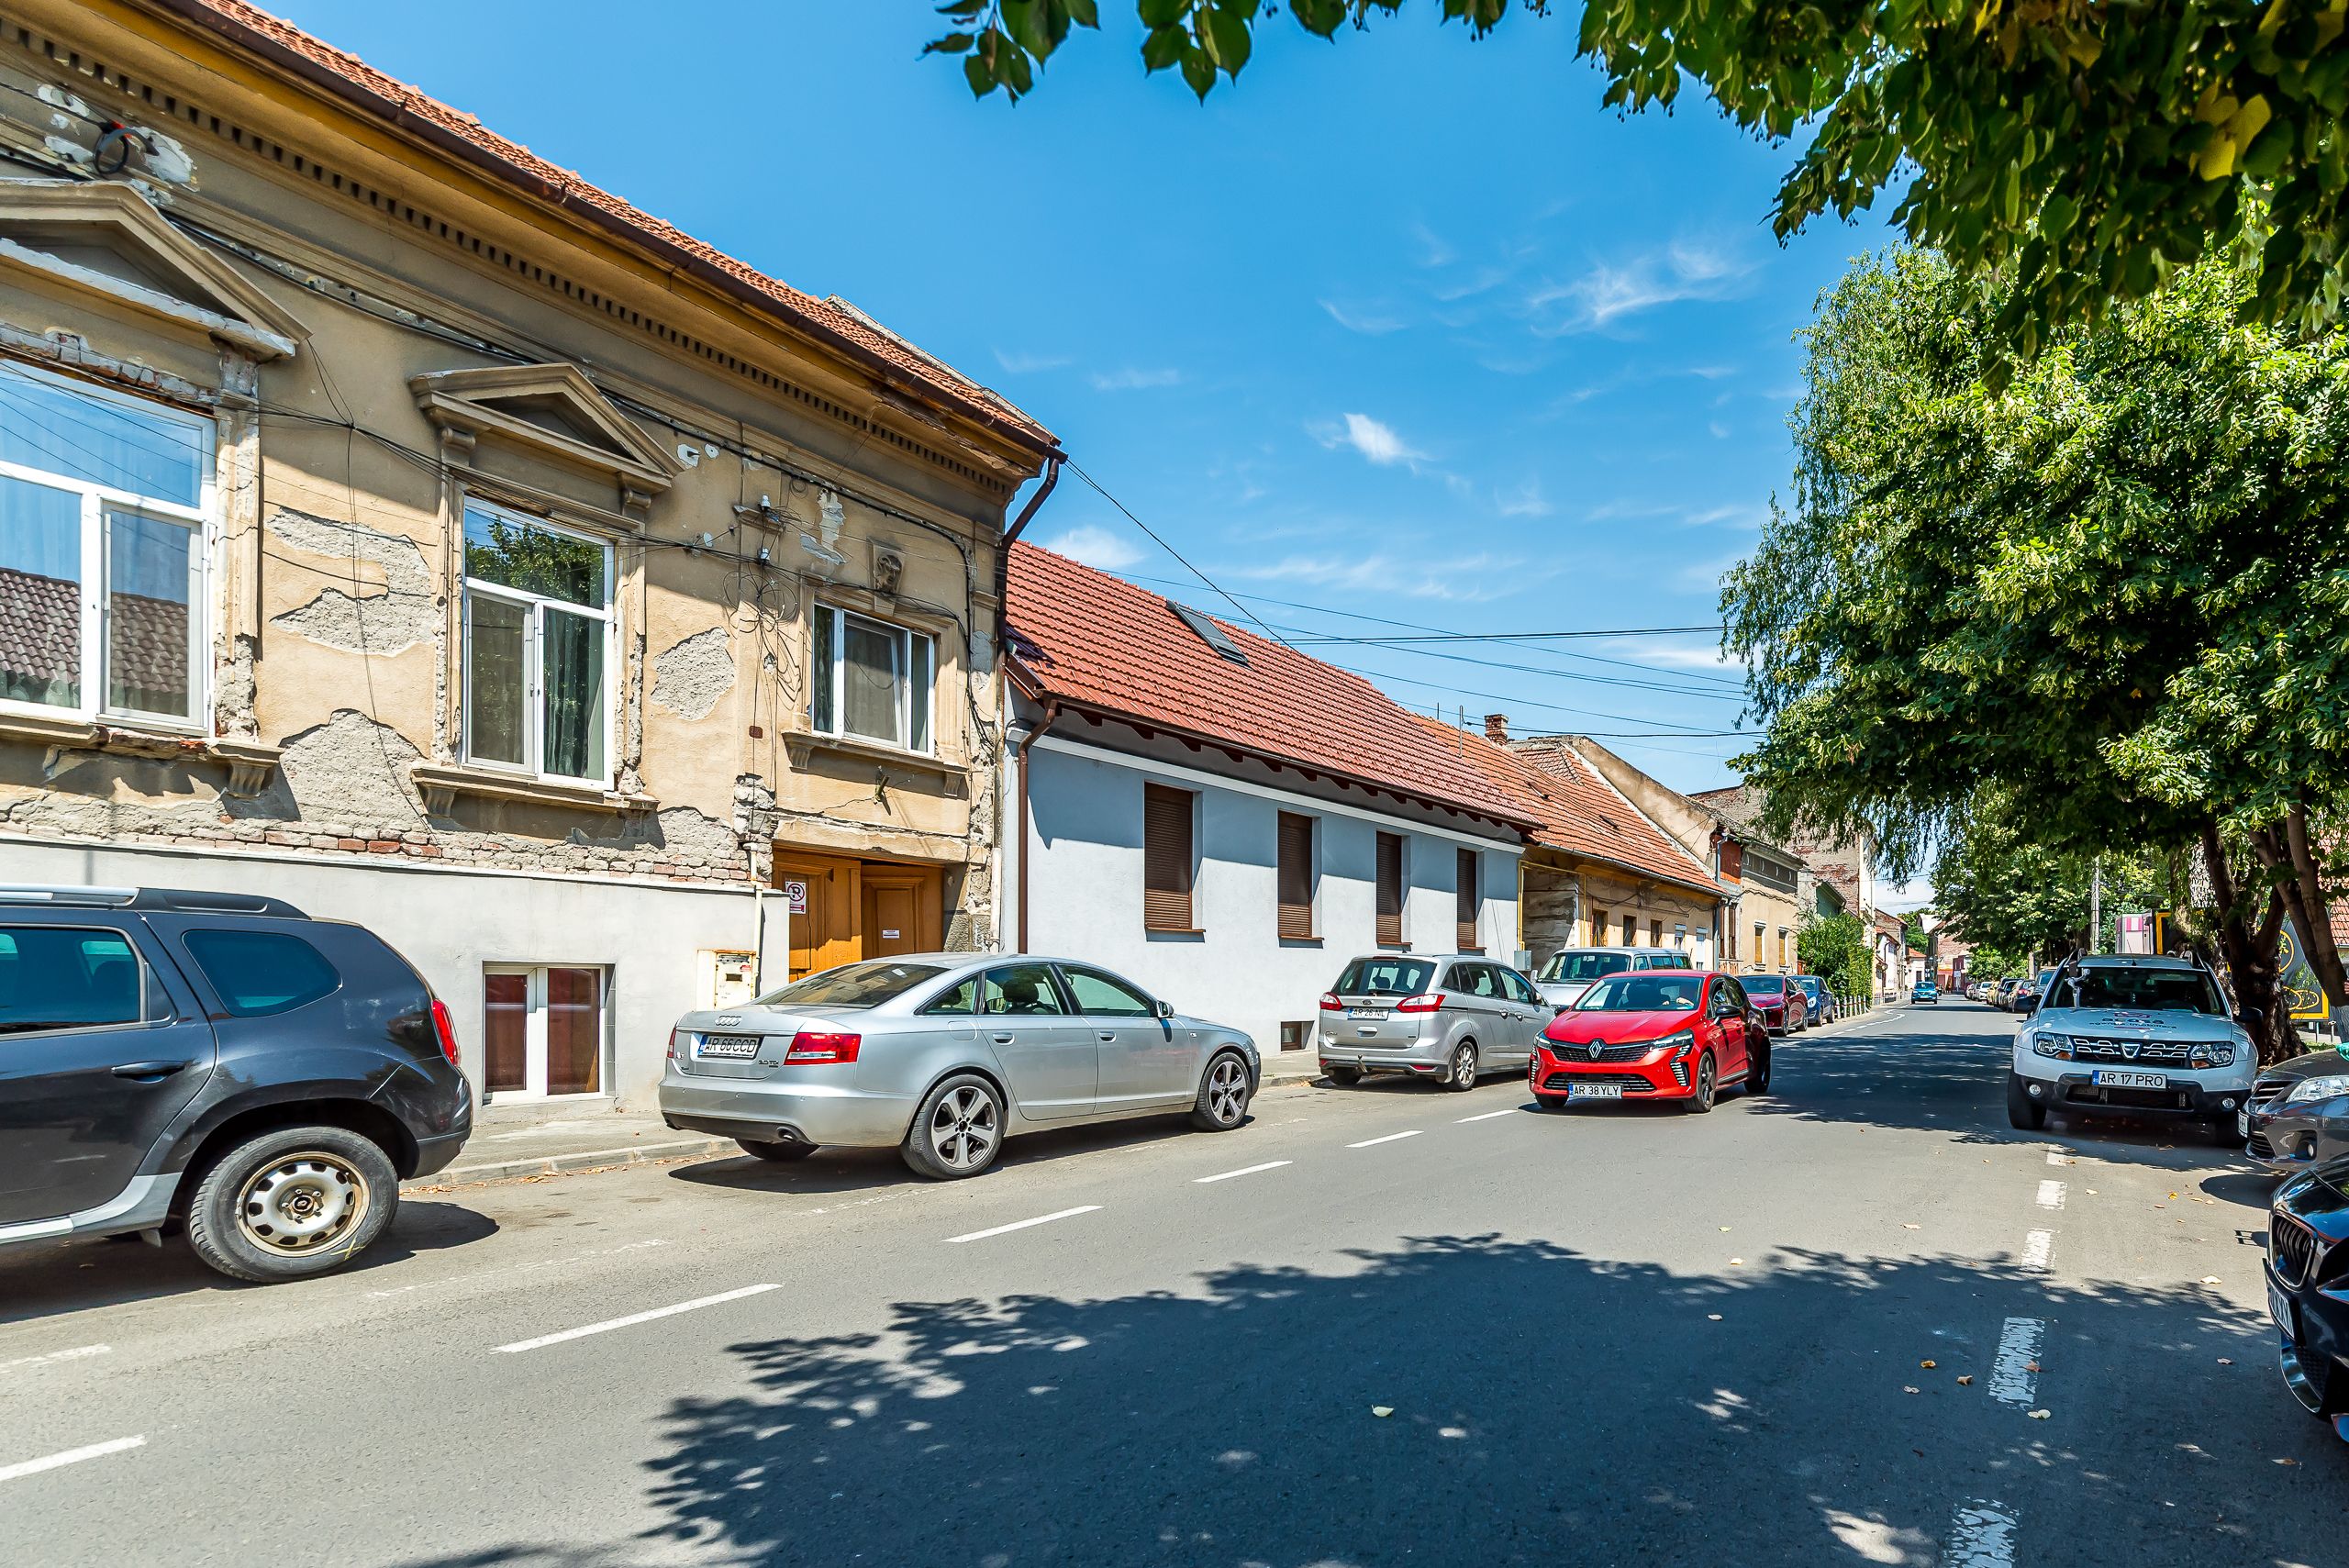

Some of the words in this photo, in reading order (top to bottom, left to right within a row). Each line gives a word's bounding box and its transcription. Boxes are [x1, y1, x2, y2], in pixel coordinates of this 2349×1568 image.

[1353, 1008, 1364, 1017] AR
[704, 1037, 719, 1051] AR
[2099, 1073, 2116, 1084] AR
[2120, 1073, 2132, 1085] 17
[2135, 1074, 2164, 1087] PRO
[1574, 1085, 1586, 1095] AR
[1588, 1085, 1599, 1095] 38
[1600, 1085, 1620, 1096] YLY
